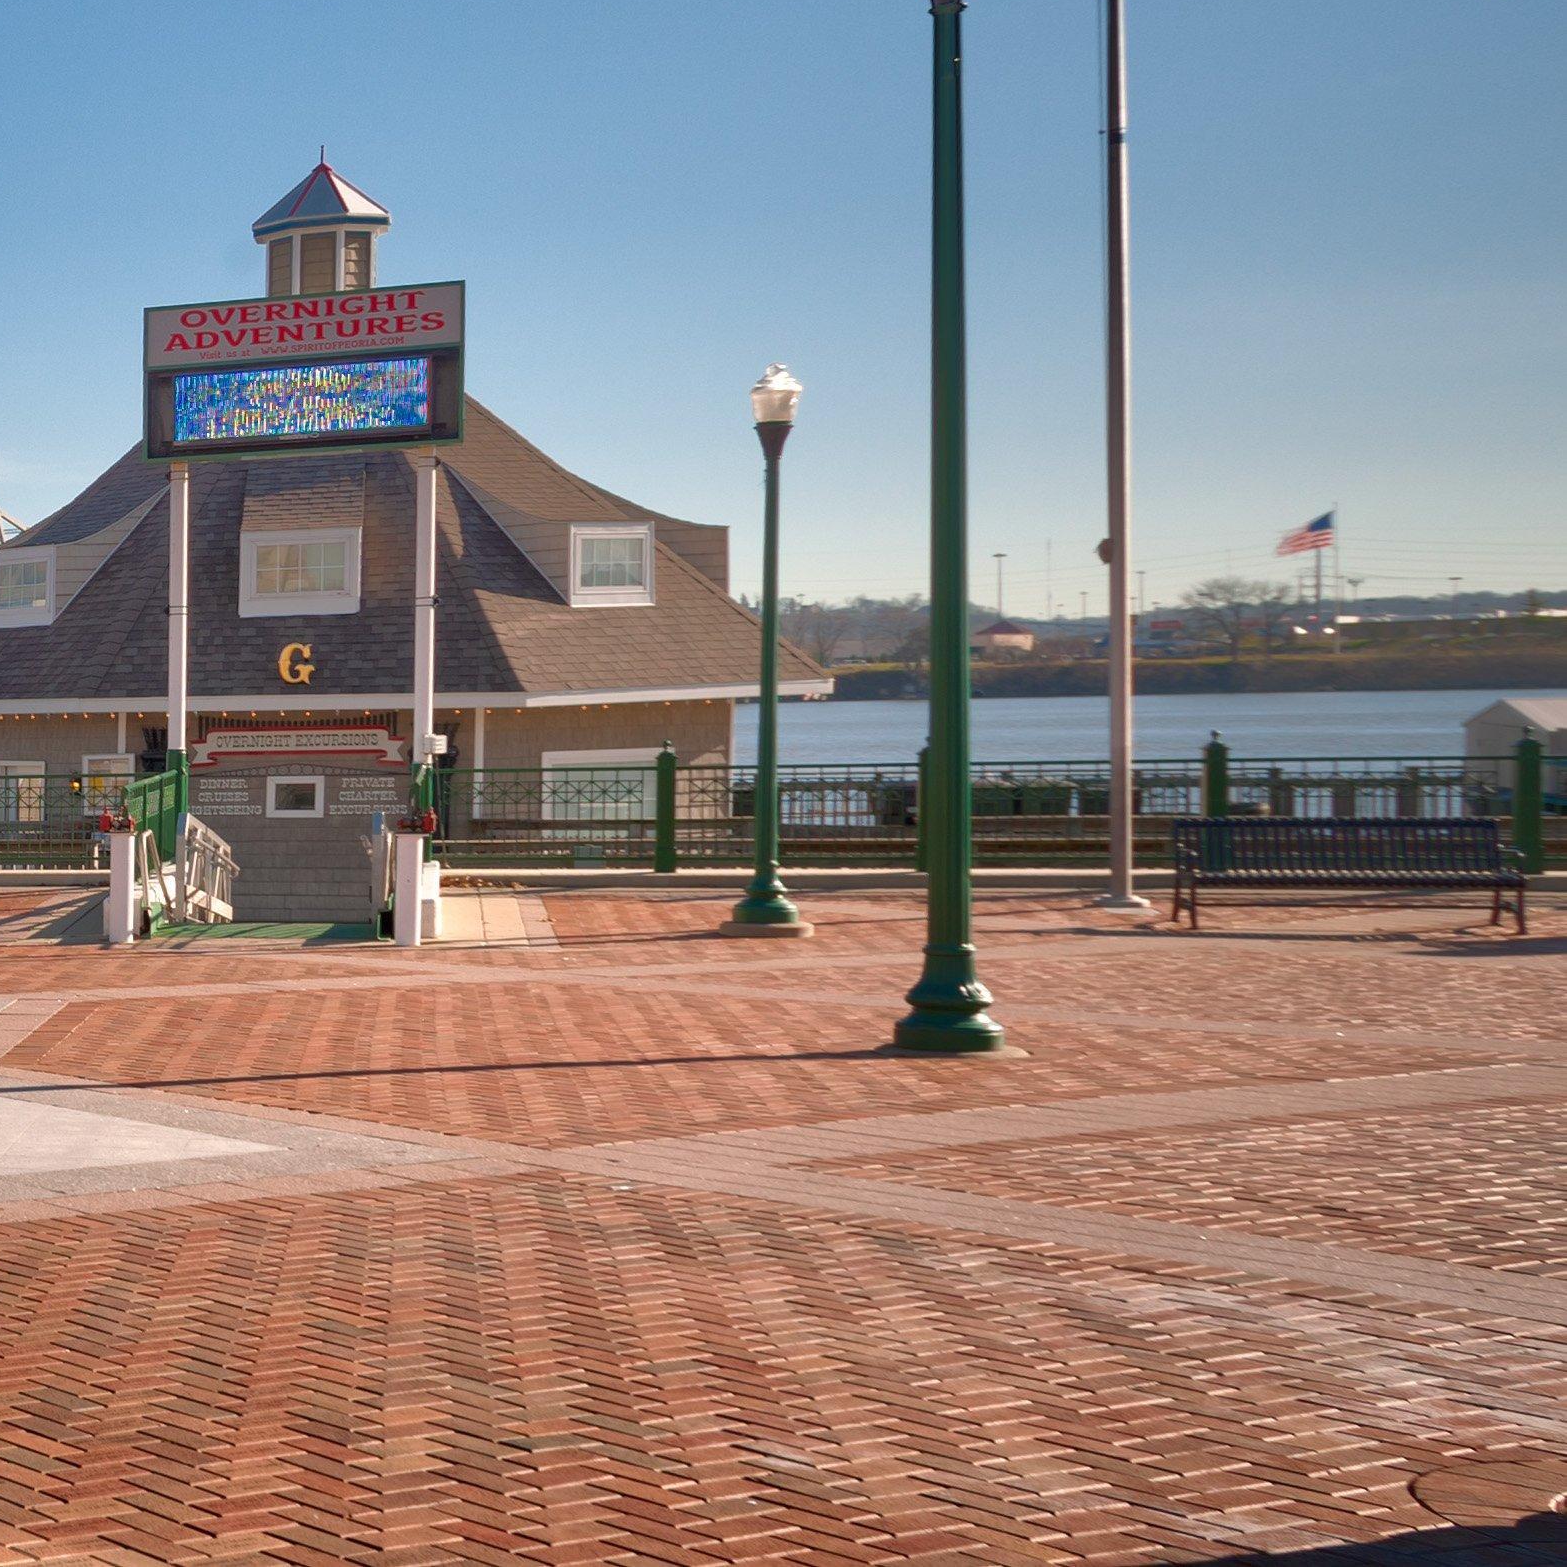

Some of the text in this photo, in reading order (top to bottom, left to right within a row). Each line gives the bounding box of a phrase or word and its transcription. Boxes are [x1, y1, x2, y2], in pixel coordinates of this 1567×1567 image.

[180, 291, 425, 328] OVERNIGHT
[164, 312, 446, 352] ADVENTURES
[199, 350, 222, 360] Visit
[278, 642, 315, 685] G
[216, 733, 379, 749] OVERNIGHT EXCURSIONS
[199, 779, 248, 789] DINNER
[341, 777, 396, 788] PRIVATE
[197, 792, 250, 802] CRUISES
[338, 791, 398, 801] CHARTER
[189, 805, 263, 816] IGHTSEEING
[329, 805, 408, 815] EXCURSIONS
